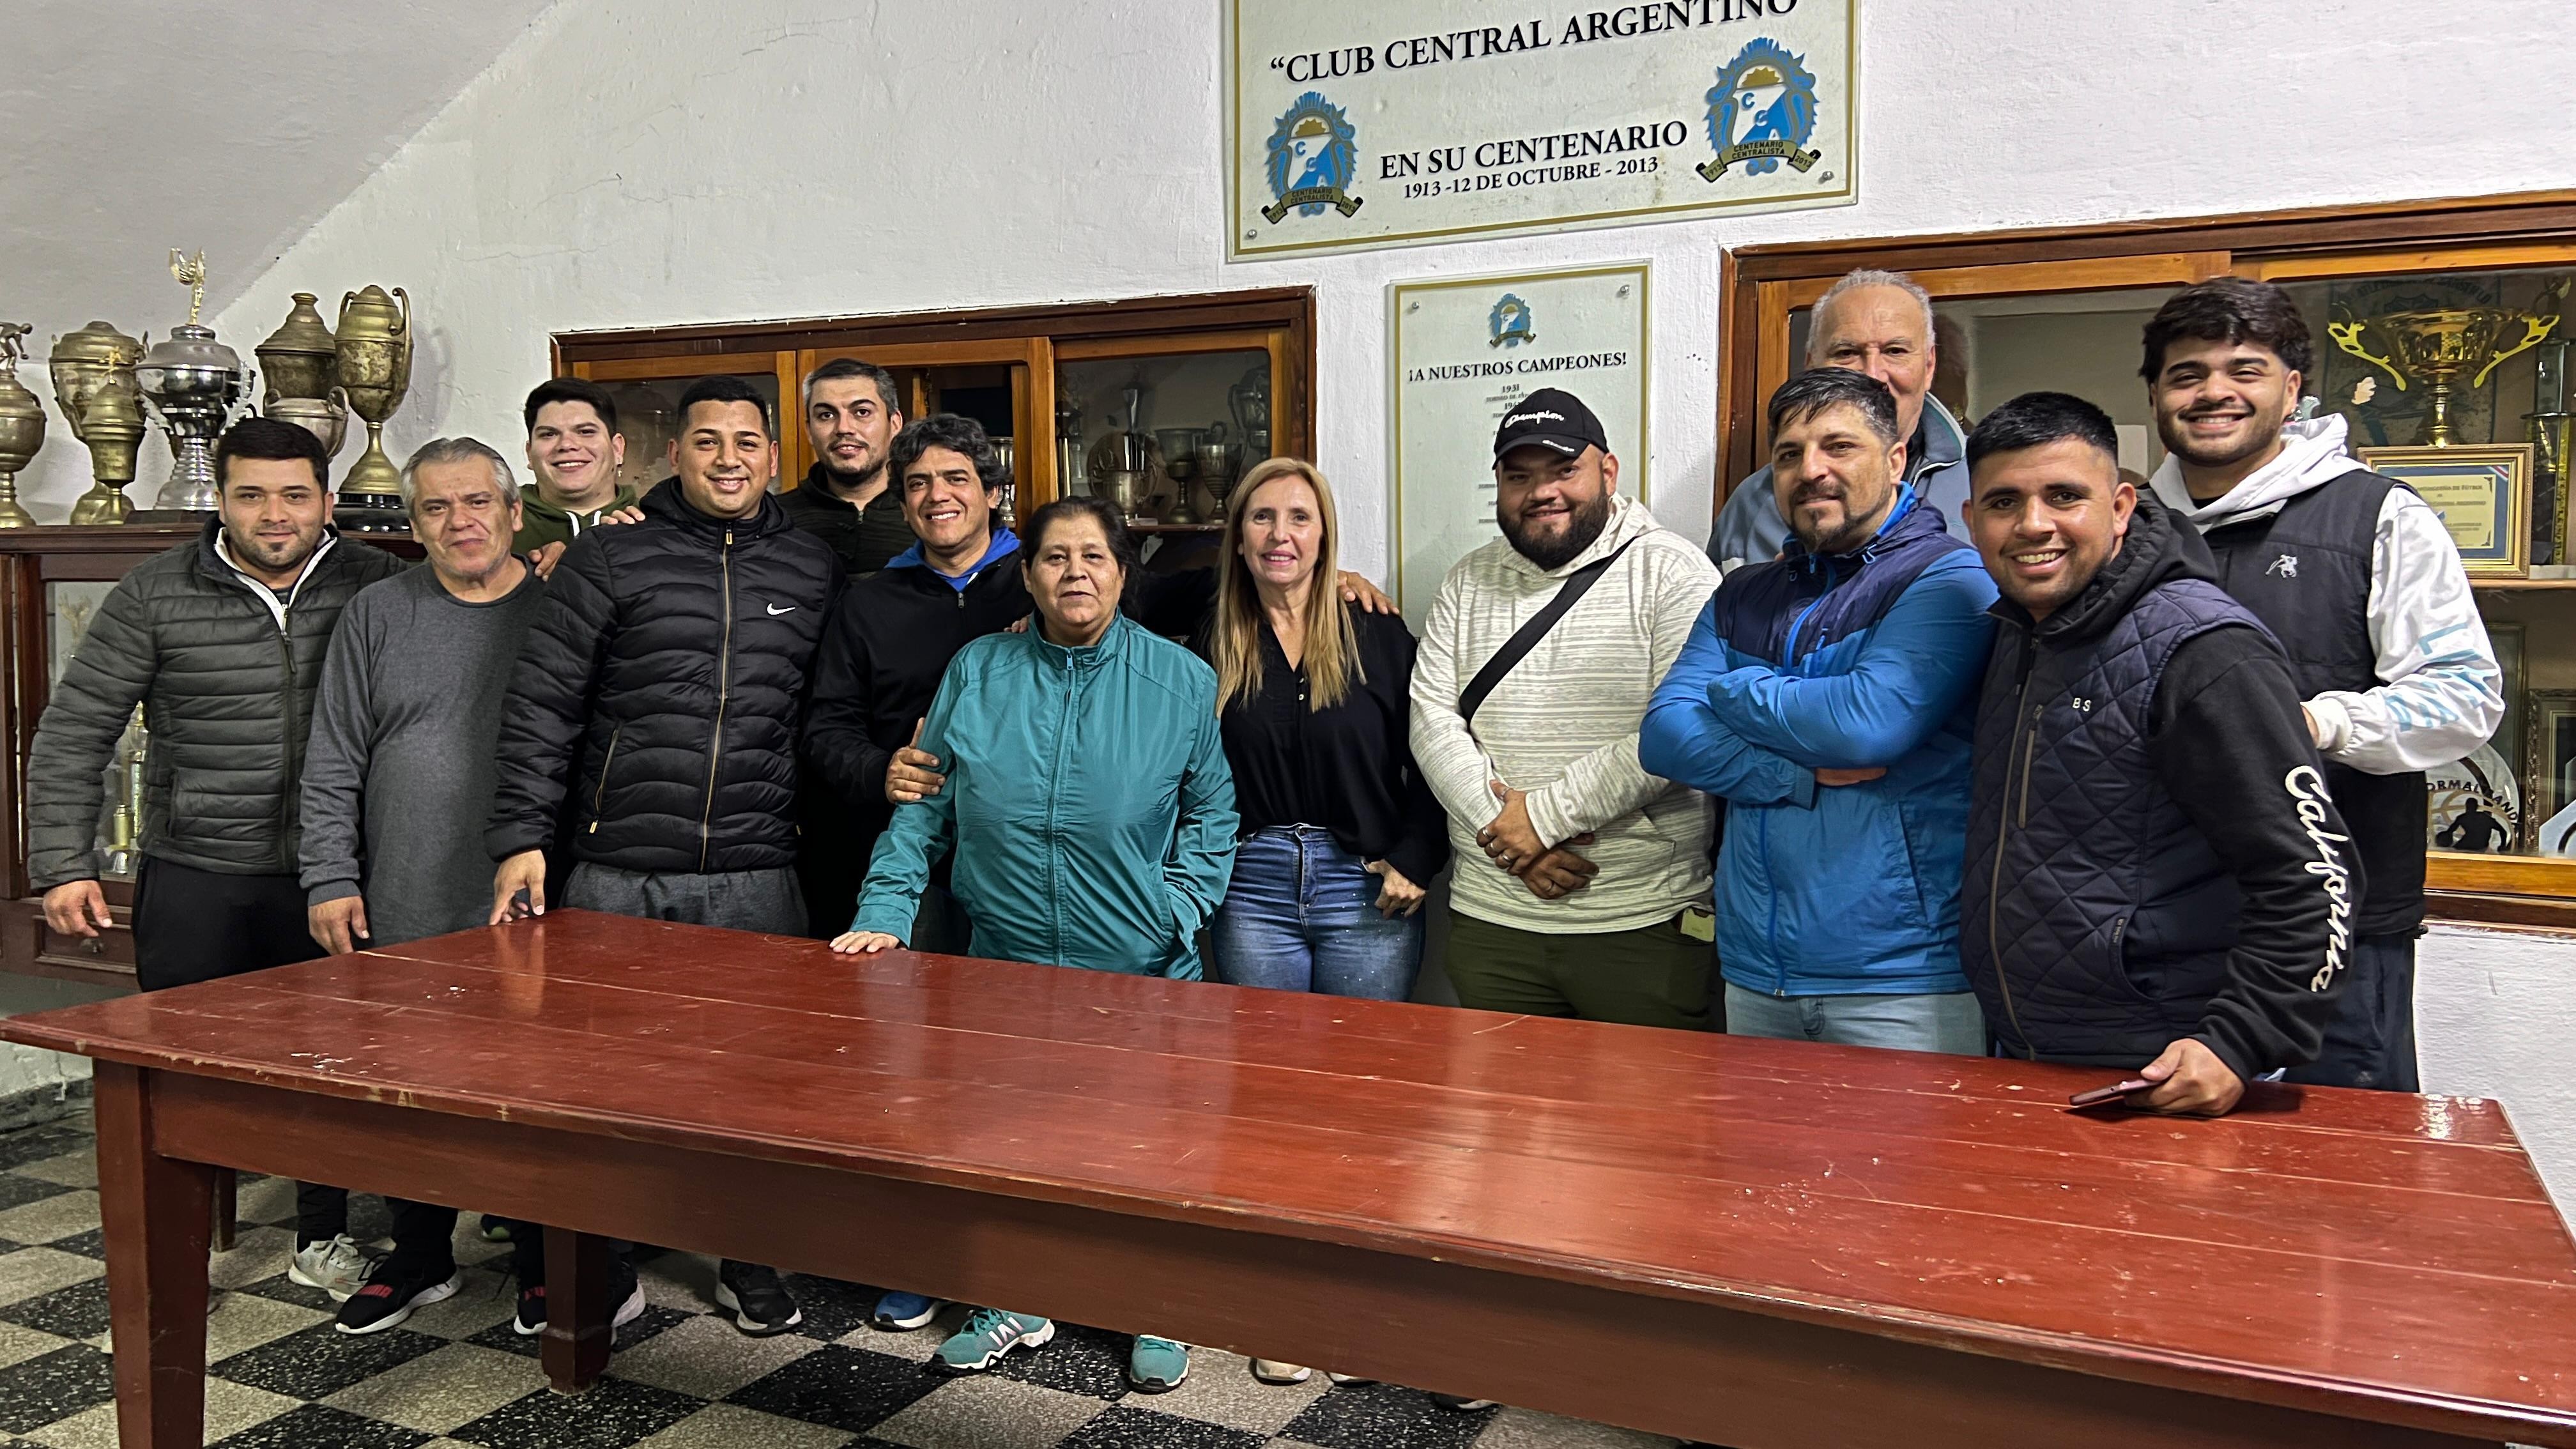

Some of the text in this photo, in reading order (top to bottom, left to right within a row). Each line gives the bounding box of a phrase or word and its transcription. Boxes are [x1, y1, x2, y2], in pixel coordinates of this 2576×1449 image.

[1271, 45, 1375, 82] “CLUB
[1384, 20, 1552, 68] CENTRAL
[1379, 120, 1687, 179] EN SU CENTENARIO
[1732, 148, 1785, 160] CENTRALISTA
[1795, 155, 1813, 168] 2013
[1404, 180, 1441, 199] 1913
[1476, 172, 1503, 191] DE
[1506, 162, 1602, 187] OCTUBRE
[1617, 157, 1659, 176] 2013
[1429, 360, 1514, 381] NUESTROS
[1517, 351, 1627, 373] CAMPEONES!
[1502, 383, 1520, 394] 1931
[1505, 410, 1565, 429] Champion
[2285, 765, 2351, 992] California
